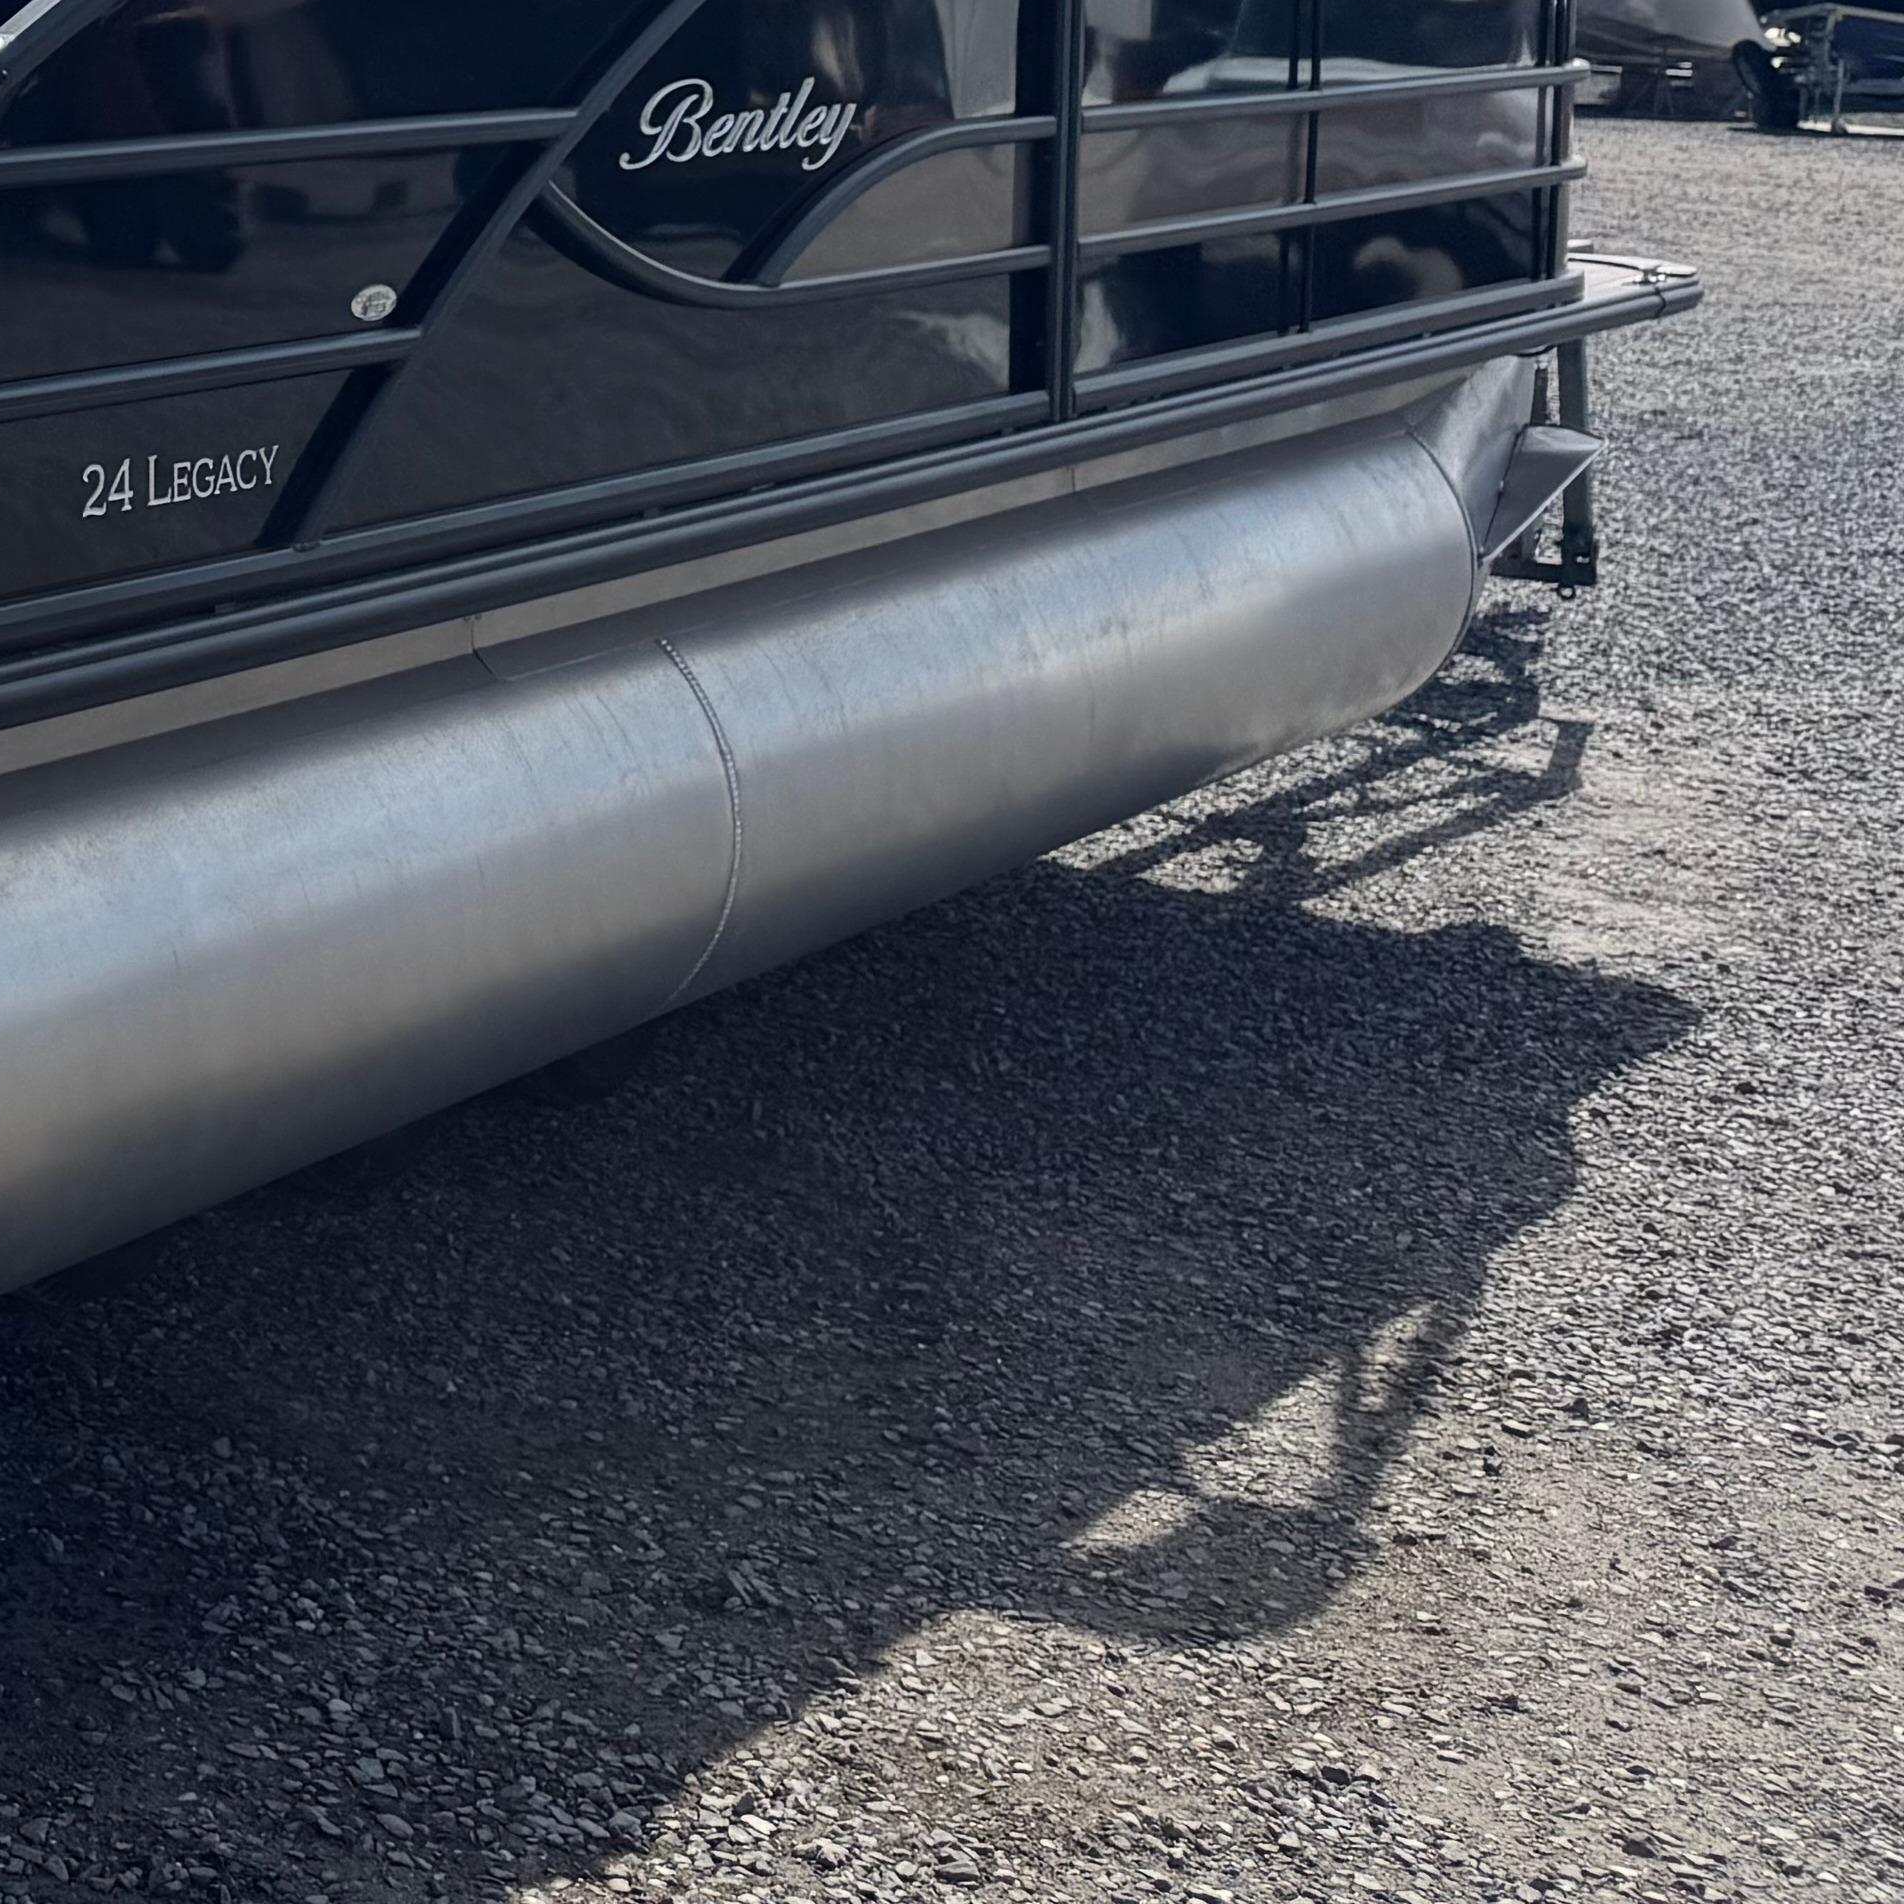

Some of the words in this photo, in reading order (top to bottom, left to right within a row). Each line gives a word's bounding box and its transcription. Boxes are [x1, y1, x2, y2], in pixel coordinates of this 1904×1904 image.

[619, 76, 857, 171] Bentley
[82, 457, 134, 518] 24
[147, 445, 279, 506] LEGACY
